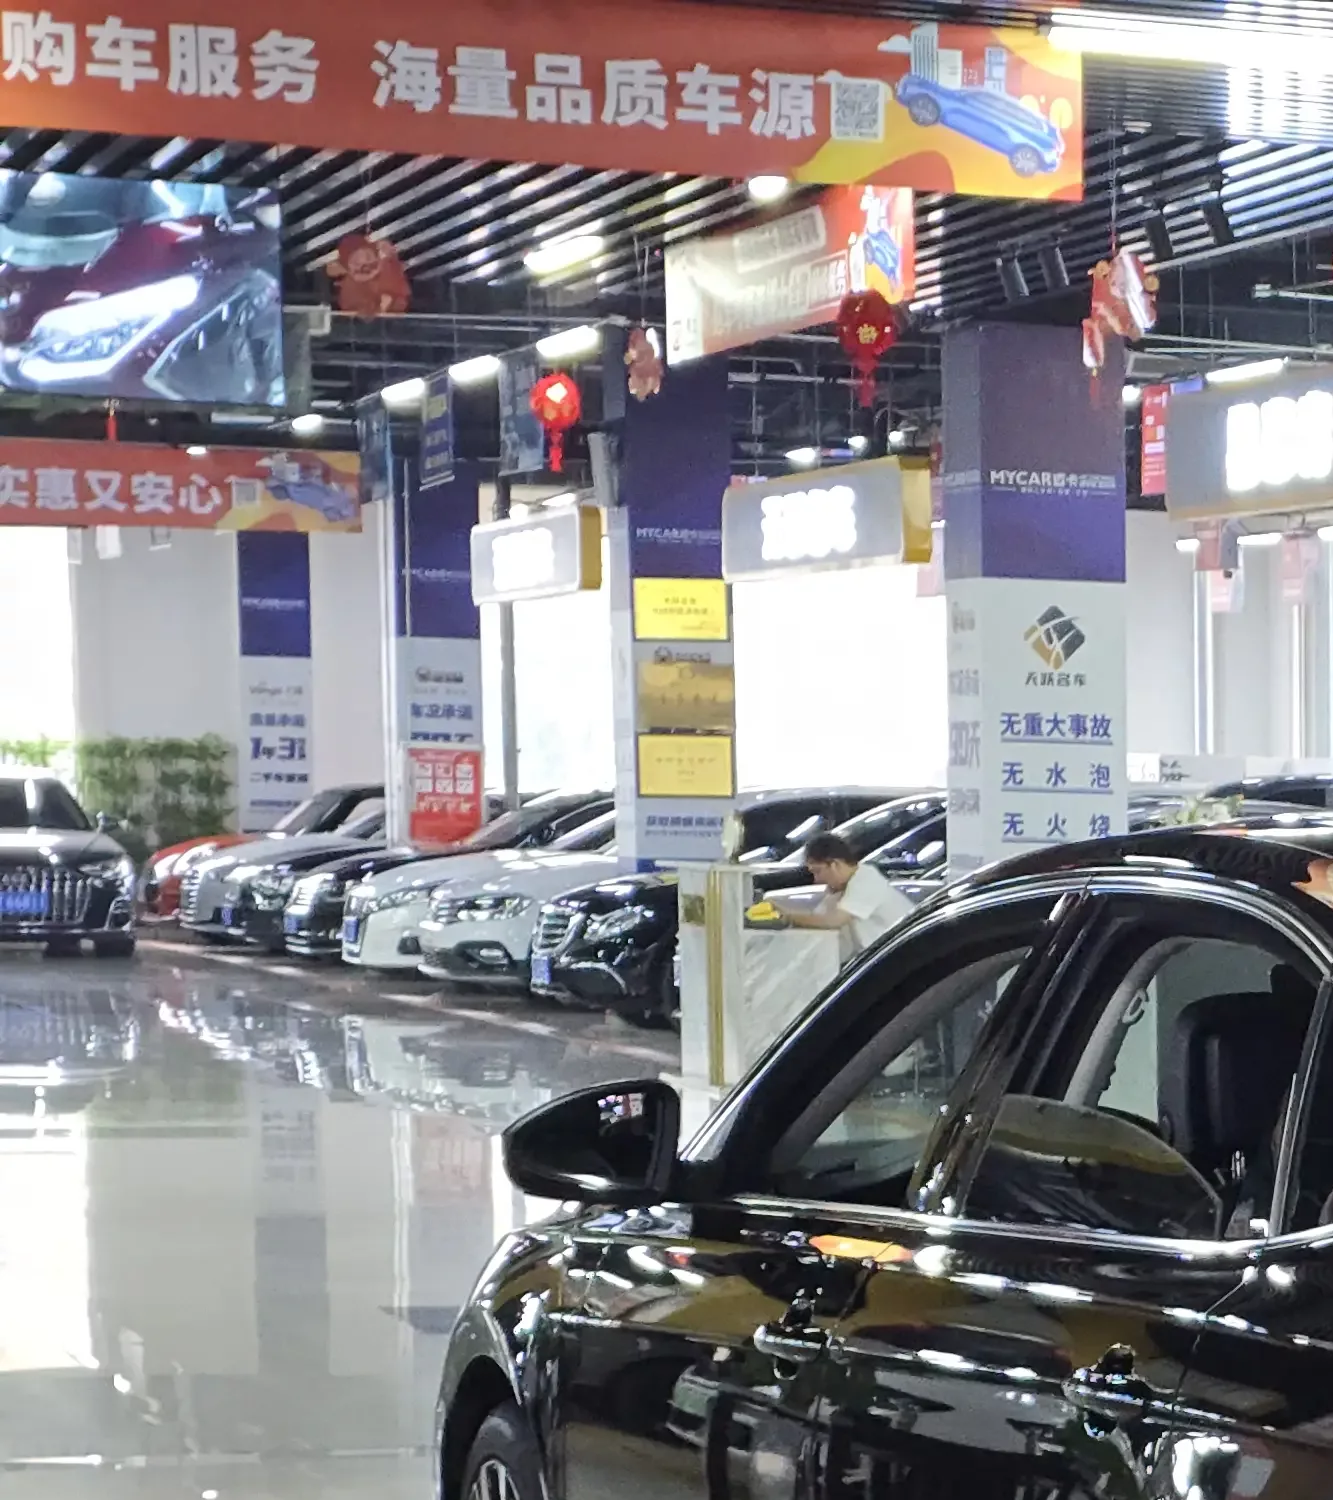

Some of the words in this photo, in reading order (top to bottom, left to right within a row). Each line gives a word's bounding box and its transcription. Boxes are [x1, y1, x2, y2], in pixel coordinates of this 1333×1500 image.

[2, 11, 320, 104] 购车服务
[371, 38, 817, 141] 海量品质车源
[1001, 712, 1112, 738] 无重大事故
